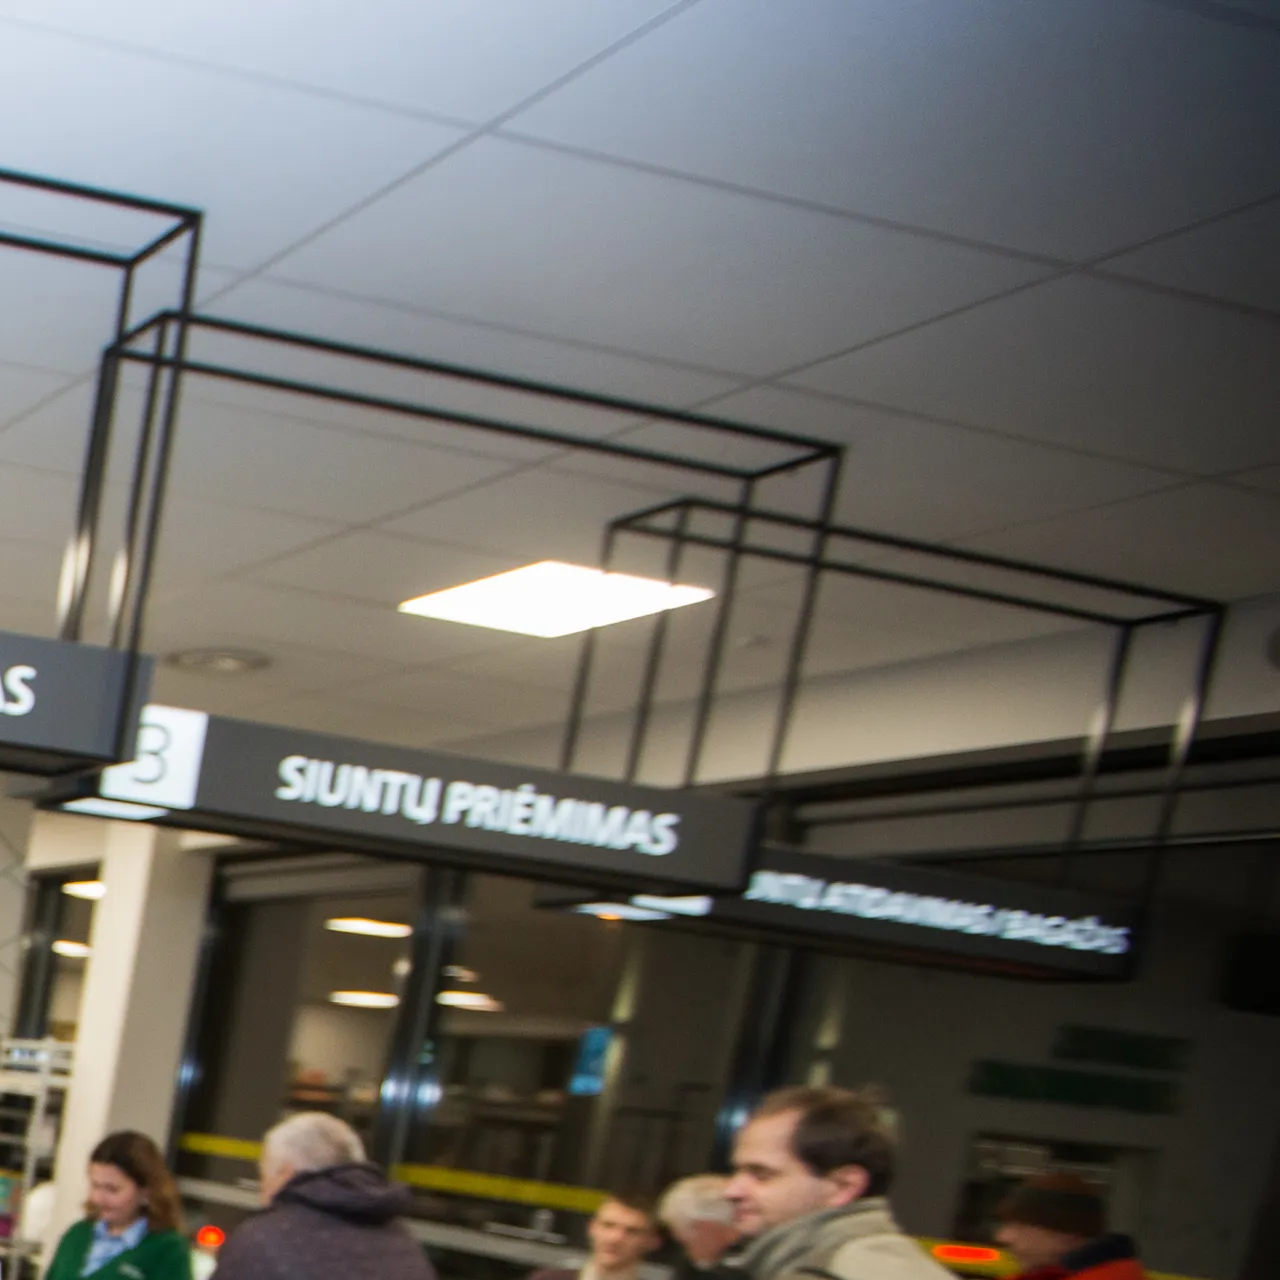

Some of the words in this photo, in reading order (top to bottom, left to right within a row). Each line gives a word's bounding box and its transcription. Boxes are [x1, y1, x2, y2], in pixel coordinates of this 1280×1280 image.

[131, 722, 172, 785] 3
[274, 754, 442, 825] SIUNTŲ
[441, 781, 681, 856] PRIĖMIMAS
